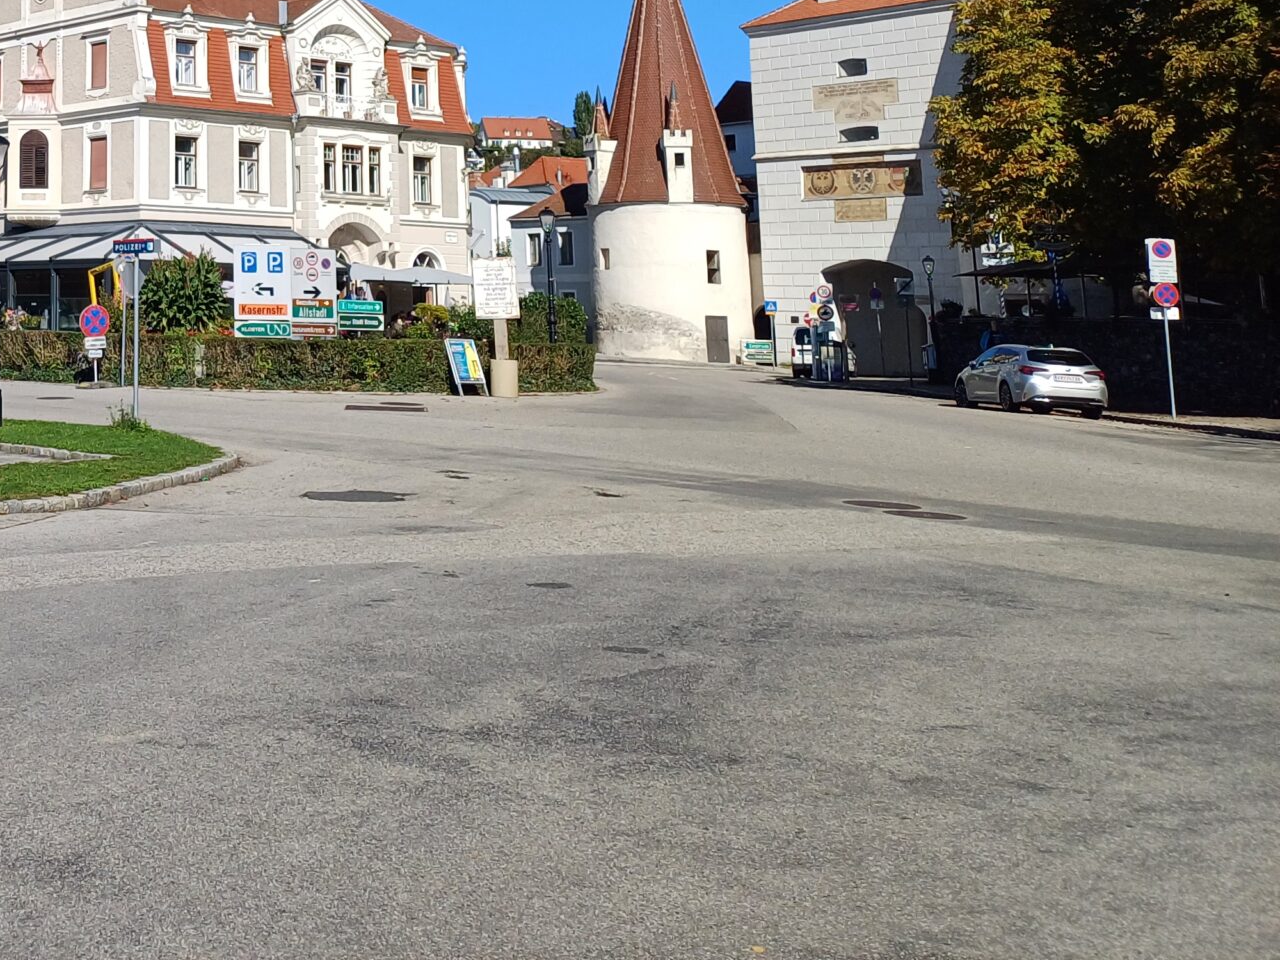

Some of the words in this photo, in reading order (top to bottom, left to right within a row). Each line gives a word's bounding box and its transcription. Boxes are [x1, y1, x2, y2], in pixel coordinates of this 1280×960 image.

[115, 243, 142, 252] POLIZEI
[244, 256, 255, 271] P
[271, 254, 281, 271] P
[241, 305, 286, 316] Kasernstr.
[298, 307, 327, 318] Altstadt
[347, 303, 374, 311] Information
[266, 323, 290, 336] UND
